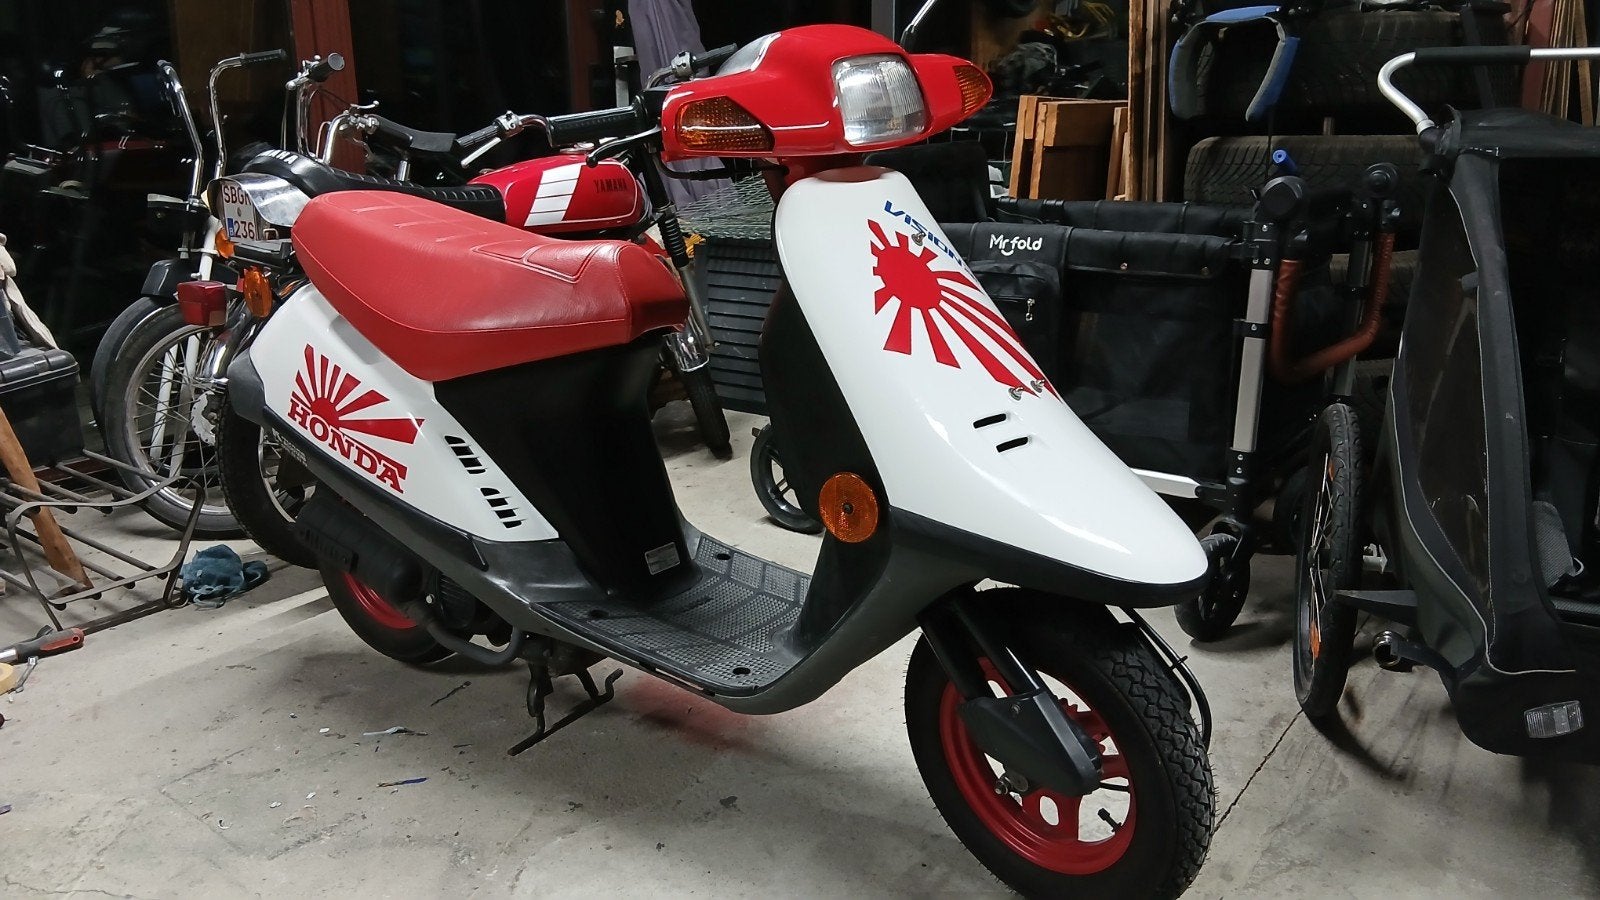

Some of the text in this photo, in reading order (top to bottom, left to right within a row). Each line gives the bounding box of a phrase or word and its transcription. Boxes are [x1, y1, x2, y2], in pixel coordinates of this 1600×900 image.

[593, 178, 628, 193] YAMAHA
[234, 221, 255, 239] 236
[884, 200, 963, 267] VISION
[287, 399, 404, 494] HONDA
